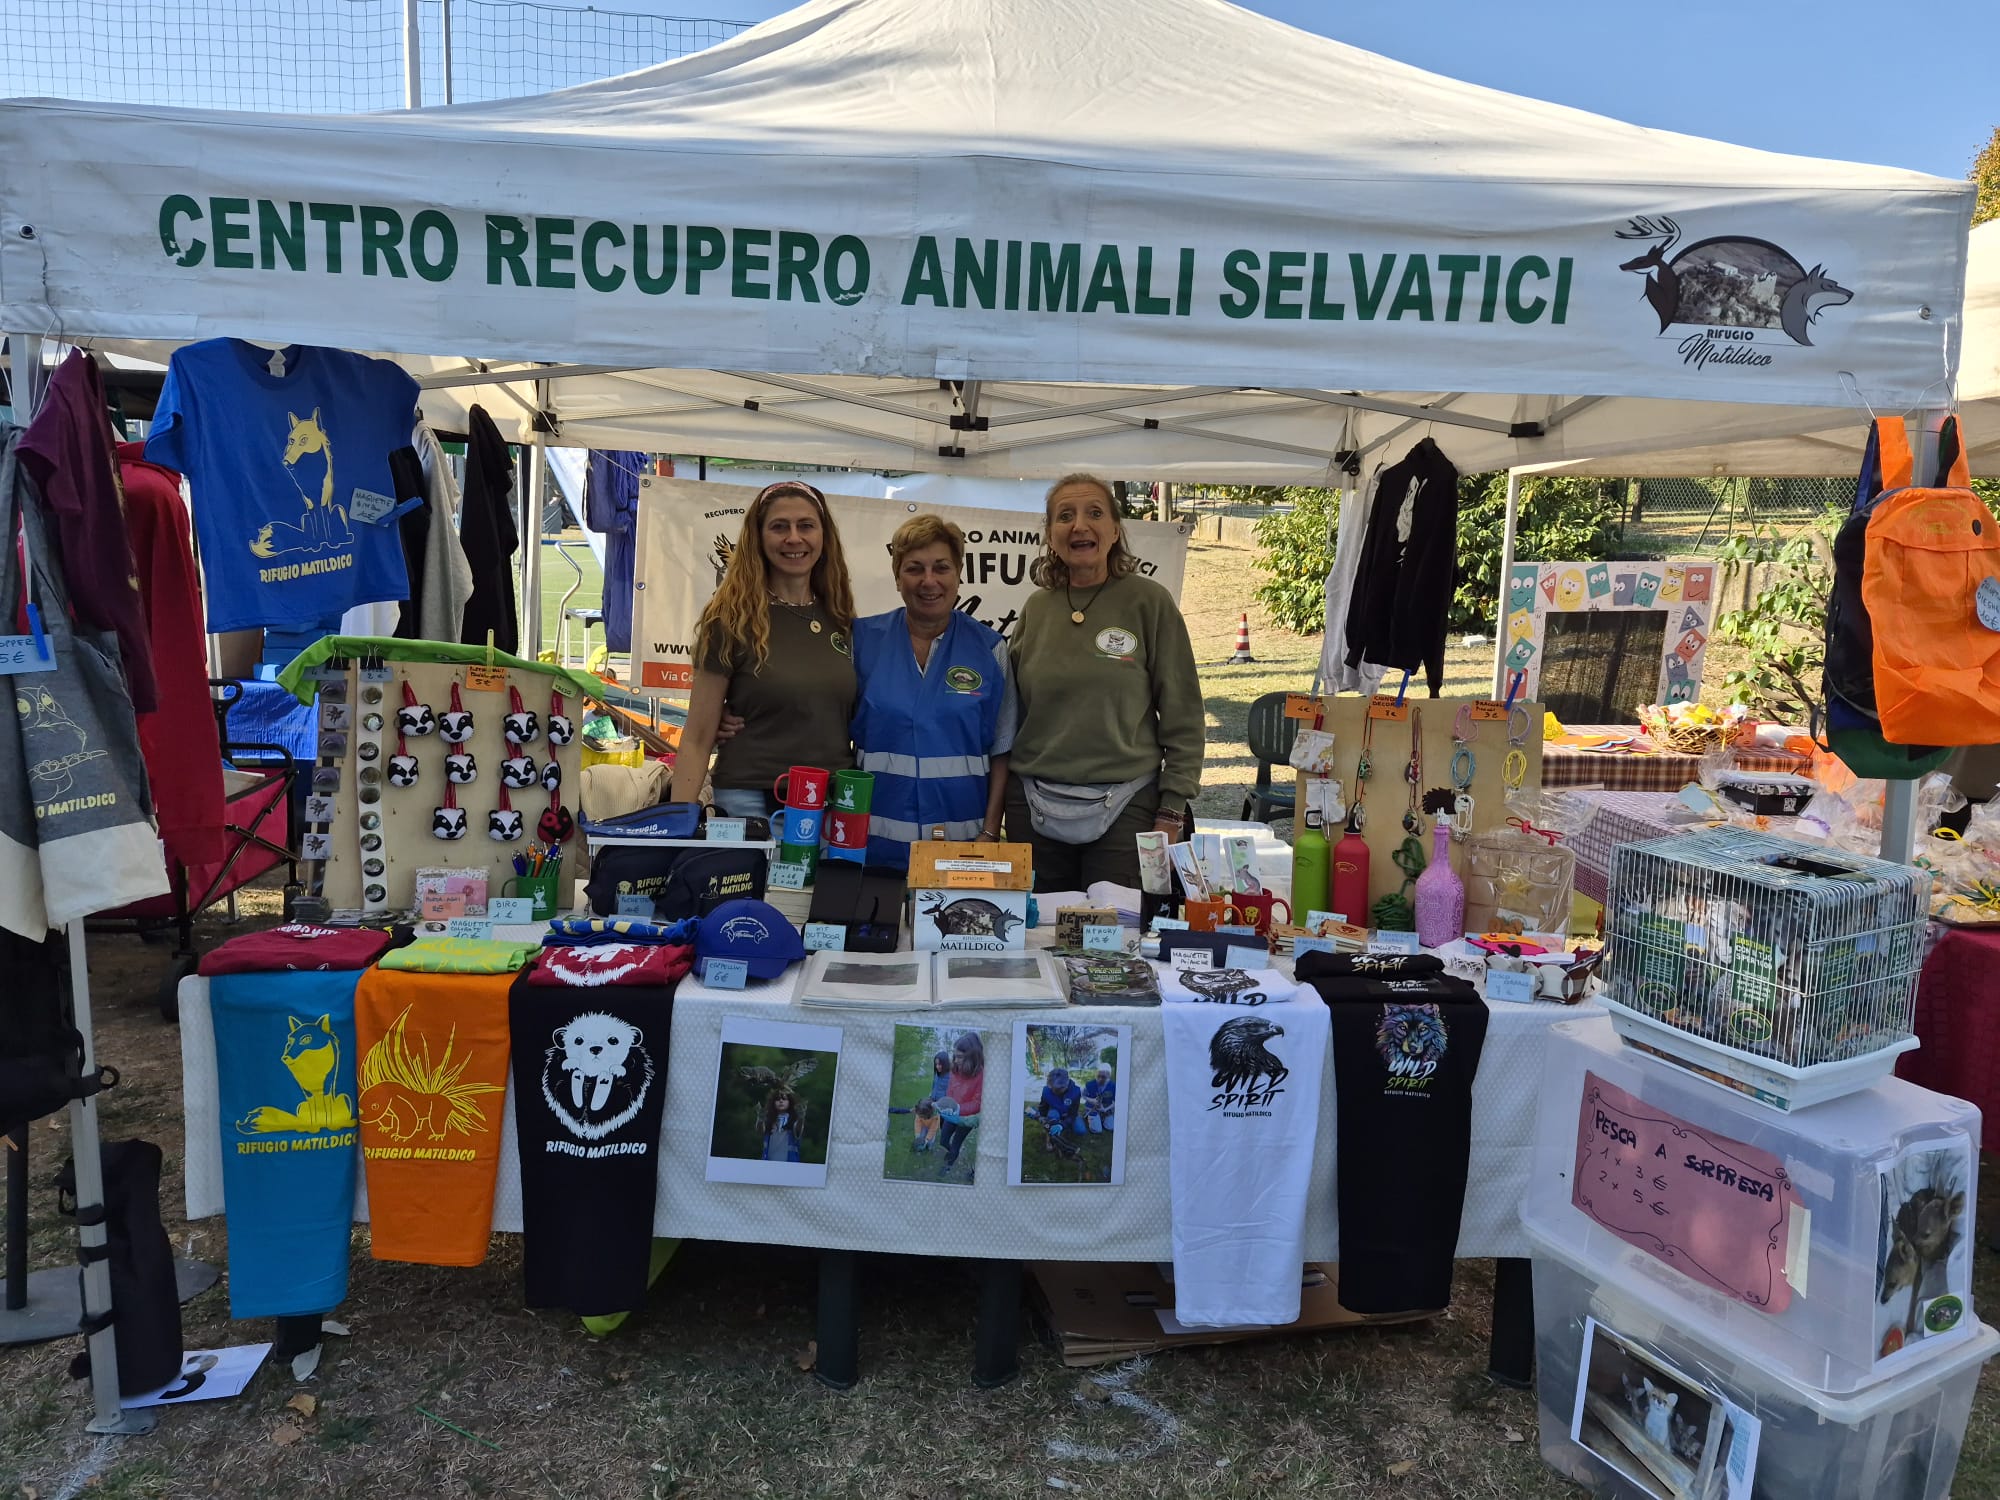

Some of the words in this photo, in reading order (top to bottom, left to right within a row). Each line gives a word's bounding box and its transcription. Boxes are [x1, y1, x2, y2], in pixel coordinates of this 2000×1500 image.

[158, 194, 459, 283] CENTRO
[485, 213, 871, 307] RECUPERO
[900, 235, 1195, 316] ANIMALI
[1219, 248, 1574, 325] SELVATICI
[1706, 328, 1754, 341] RIFUGIO
[1677, 334, 1773, 371] Matildico
[704, 508, 746, 520] RECUPERO
[259, 564, 299, 584] RIFUGIO
[300, 553, 353, 577] MATILDICO
[661, 671, 678, 682] Via
[48, 792, 116, 817] MATILDICO
[722, 872, 751, 885] RIFUGIO
[496, 900, 519, 908] BIRO
[806, 931, 841, 941] OUTDOOR
[1086, 927, 1117, 935] MEMORY
[940, 942, 1004, 952] MATILDICO
[1388, 1057, 1437, 1081] WILD
[1211, 1068, 1289, 1095] WILD
[1384, 1077, 1435, 1090] SPIRIT
[1205, 1089, 1285, 1112] SPIRIT
[1595, 1109, 1637, 1149] PESCA
[1655, 1143, 1667, 1160] A
[236, 1140, 289, 1155] RIFUGIO
[364, 1146, 412, 1161] RIFUGIO
[413, 1147, 476, 1162] MATILDICO
[545, 1140, 585, 1156] RIFUGIO
[587, 1141, 647, 1159] MATILDICO
[1600, 1147, 1609, 1160] 1
[1635, 1166, 1644, 1179] 3
[1652, 1175, 1668, 1191] €
[1599, 1170, 1608, 1183] 2
[1633, 1190, 1644, 1204] 5
[1650, 1201, 1670, 1216] €
